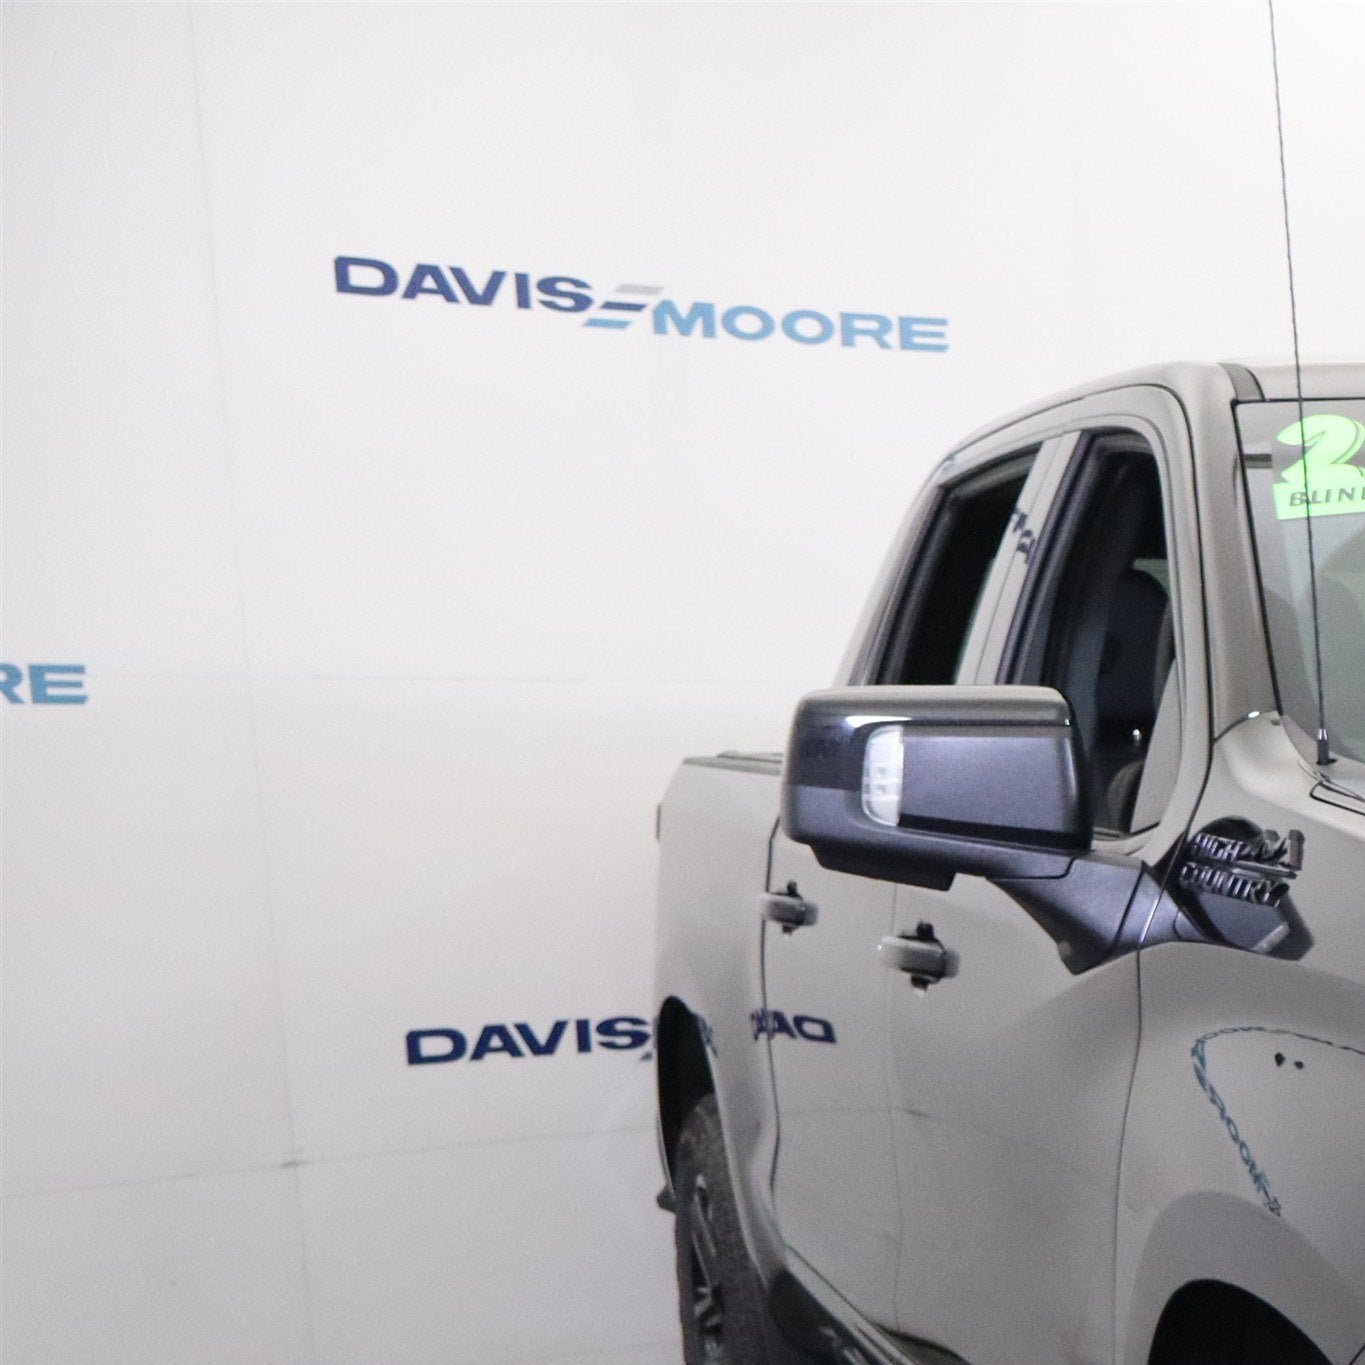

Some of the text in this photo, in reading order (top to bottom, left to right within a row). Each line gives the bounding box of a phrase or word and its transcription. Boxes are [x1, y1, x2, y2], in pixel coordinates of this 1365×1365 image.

[334, 255, 950, 353] DAVIS MOORE
[405, 1016, 651, 1066] DAVIS
